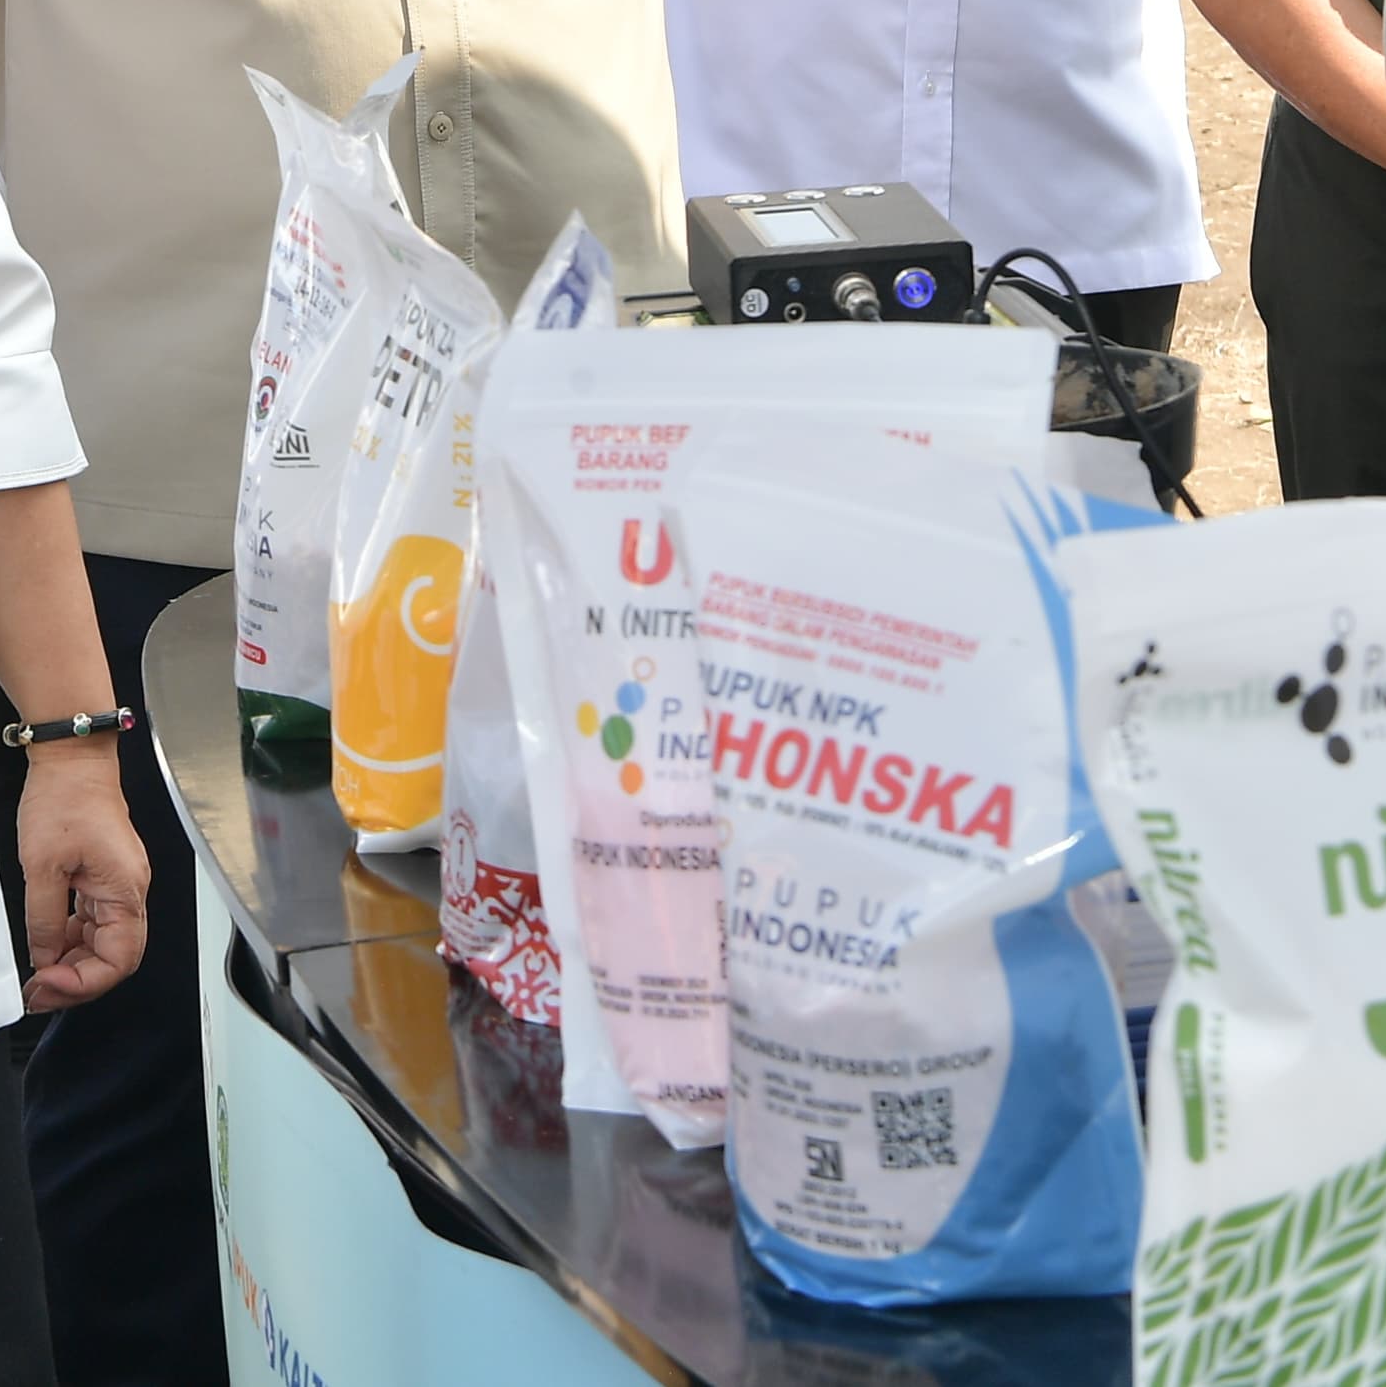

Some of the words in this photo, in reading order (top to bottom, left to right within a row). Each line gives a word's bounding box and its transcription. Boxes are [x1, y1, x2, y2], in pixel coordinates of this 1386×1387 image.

[571, 424, 642, 445] PUPUK
[576, 451, 669, 471] BARANG
[585, 606, 605, 636] N
[698, 661, 805, 717] UPUK
[808, 689, 886, 737] NPK
[705, 707, 1016, 852] HONSKA
[625, 845, 723, 870] INDONESIA
[733, 867, 922, 939] PUPUK
[730, 906, 900, 972] INDONESIA
[917, 1046, 993, 1076] GROUP
